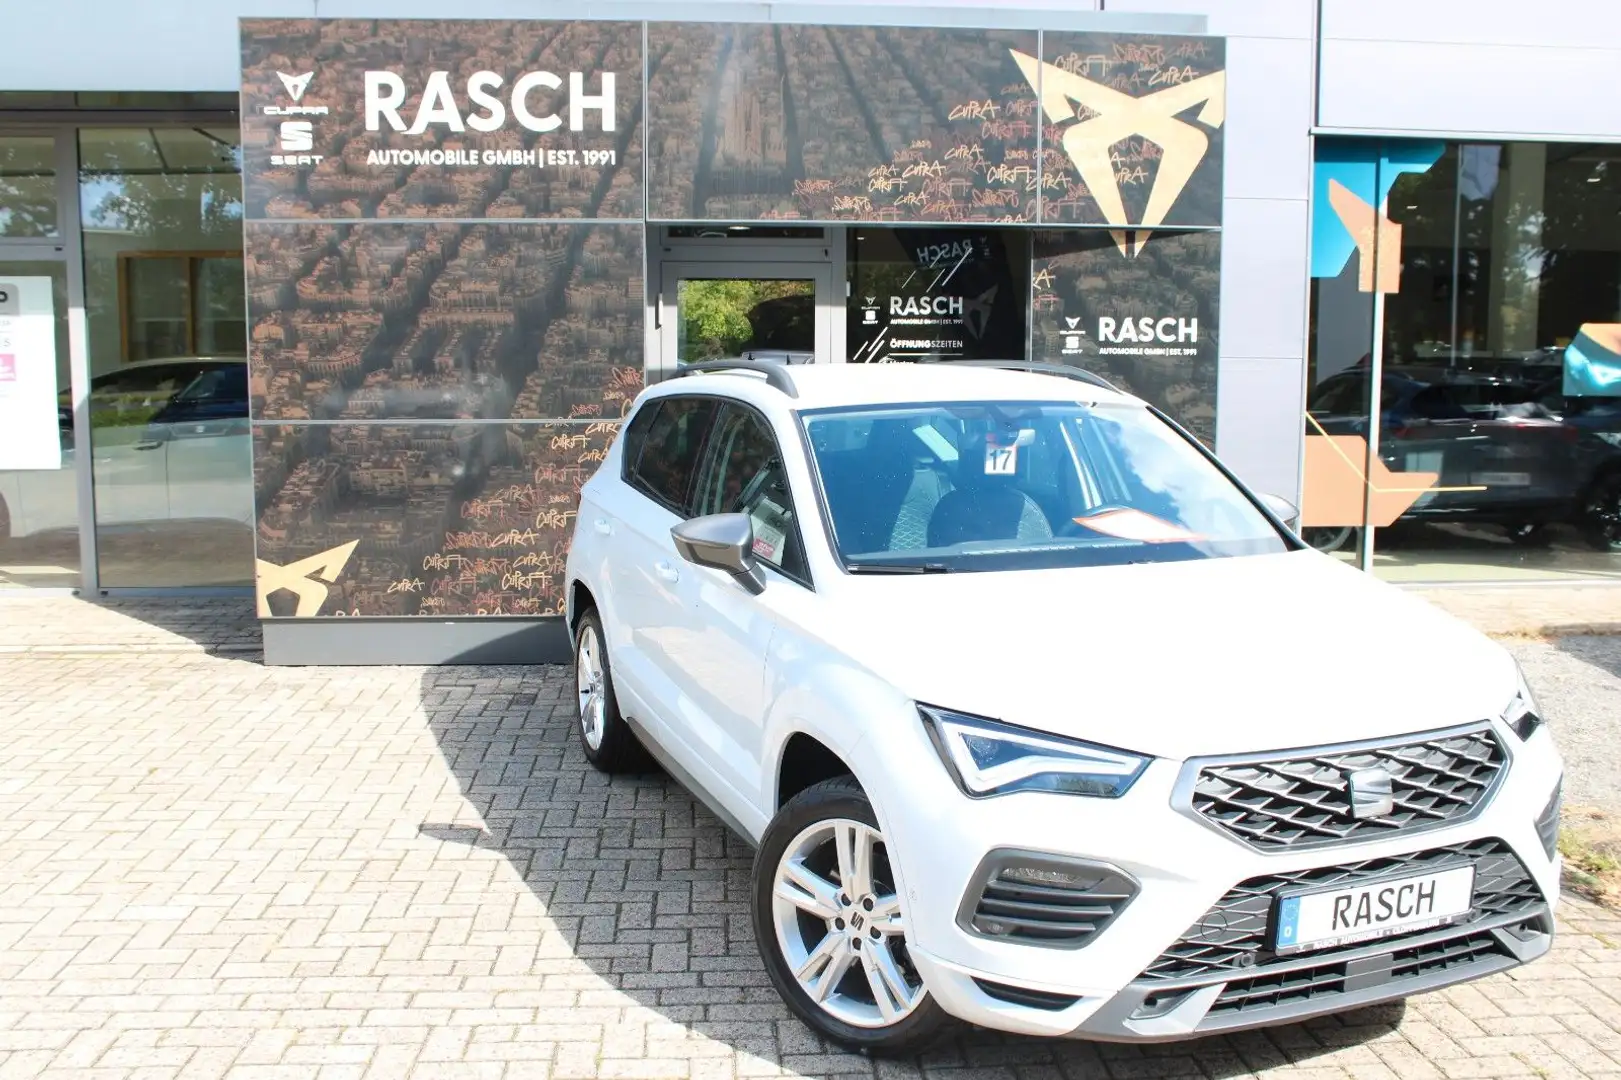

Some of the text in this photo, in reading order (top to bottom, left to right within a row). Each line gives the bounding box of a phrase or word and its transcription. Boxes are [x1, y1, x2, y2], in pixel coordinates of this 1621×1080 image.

[365, 70, 616, 135] RASCH
[948, 98, 1000, 122] CUPRA
[270, 155, 324, 165] SEAT
[367, 149, 616, 165] AUTOMOBILE GMBH EST. 1991
[944, 144, 984, 160] CUPRA
[902, 160, 946, 178] CUPRA
[894, 191, 930, 206] CUPRA
[889, 296, 964, 317] RASCH
[1098, 316, 1199, 344] RASCH
[889, 338, 964, 349] ÖFFNUNGSZEITEN
[1099, 347, 1143, 356] AUTOMOBILE
[989, 450, 1013, 471] 17
[491, 528, 540, 548] CUPRA
[513, 551, 553, 568] CUPRA
[387, 577, 426, 593] CUPRA
[1332, 880, 1436, 931] RASCH
